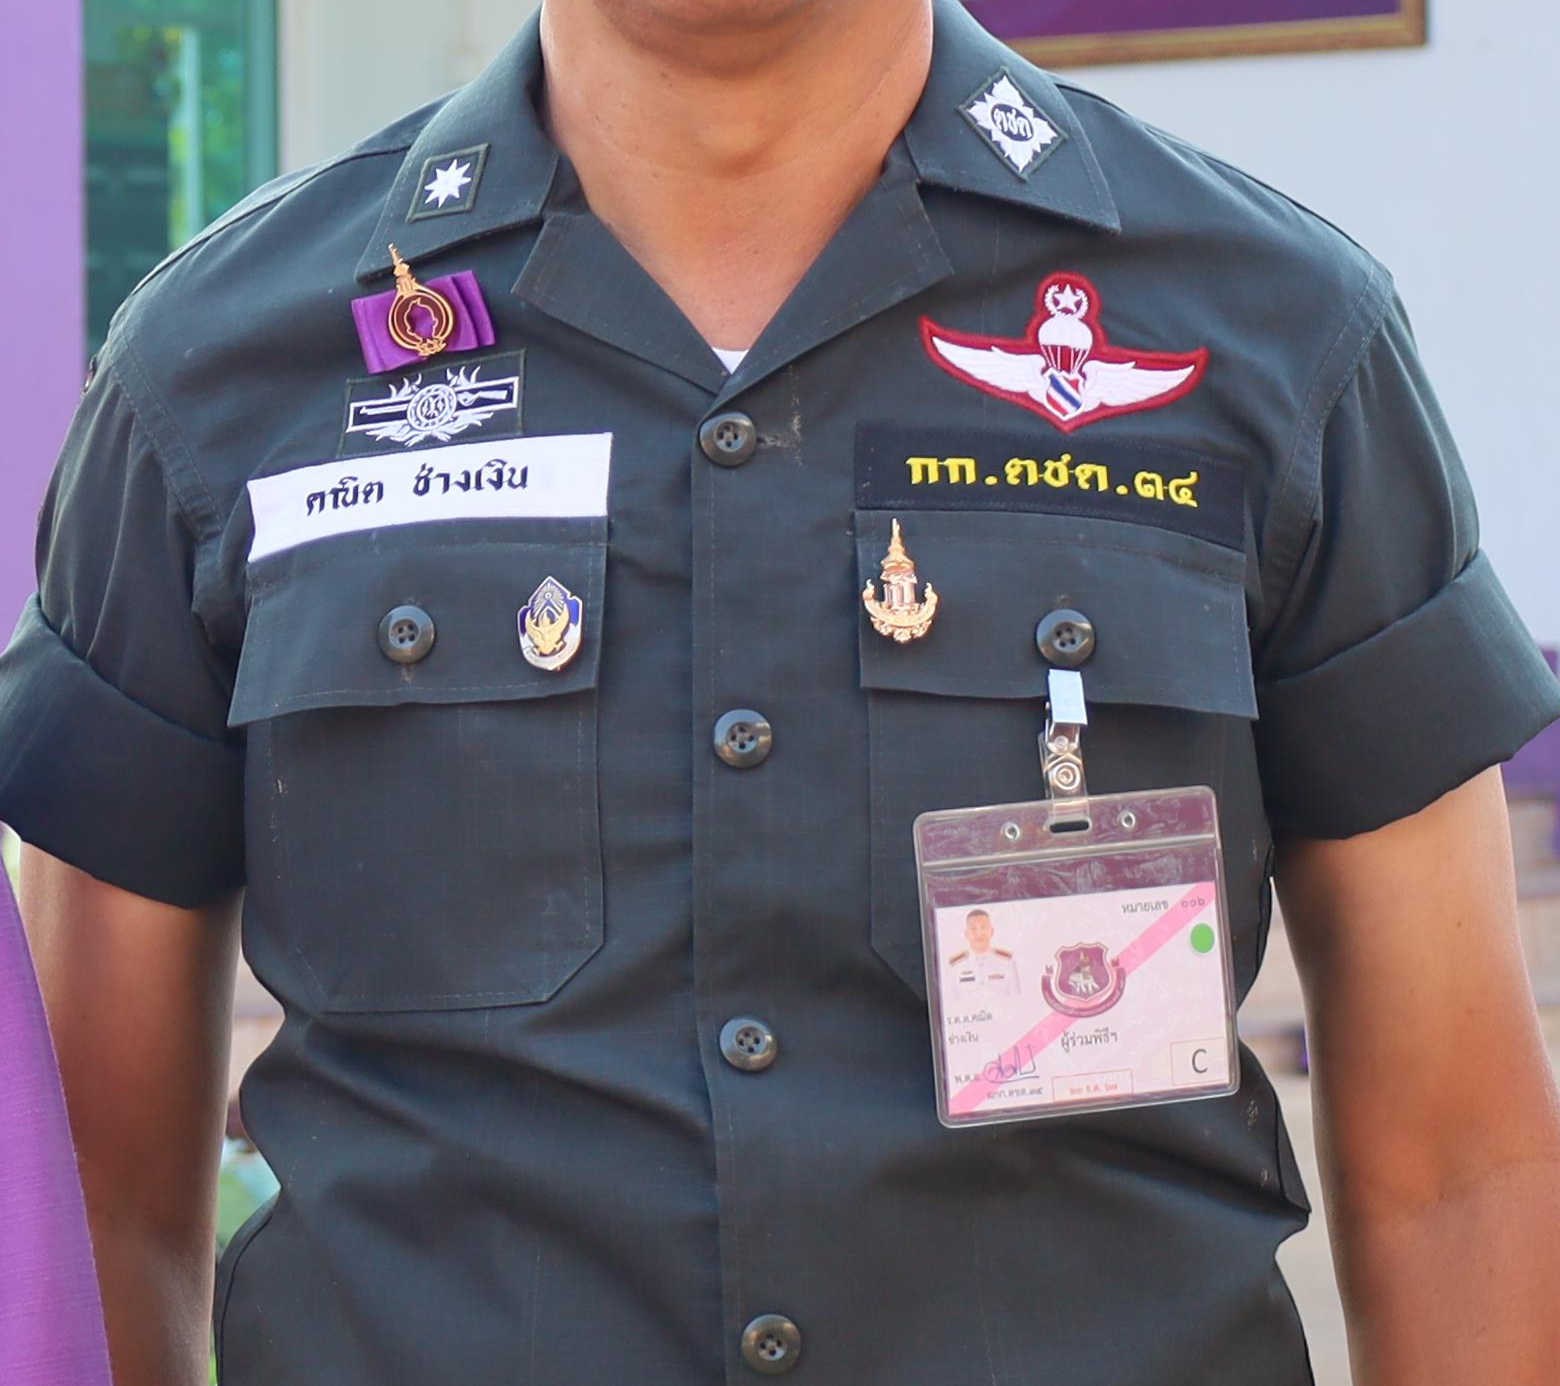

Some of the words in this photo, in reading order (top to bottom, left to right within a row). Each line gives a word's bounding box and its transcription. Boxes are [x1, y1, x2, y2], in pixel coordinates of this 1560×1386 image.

[307, 476, 384, 516] คณิต
[413, 459, 528, 497] ช่างเงิน
[905, 452, 1199, 508] กก.ตชด.๓๔
[1192, 1048, 1208, 1074] C
